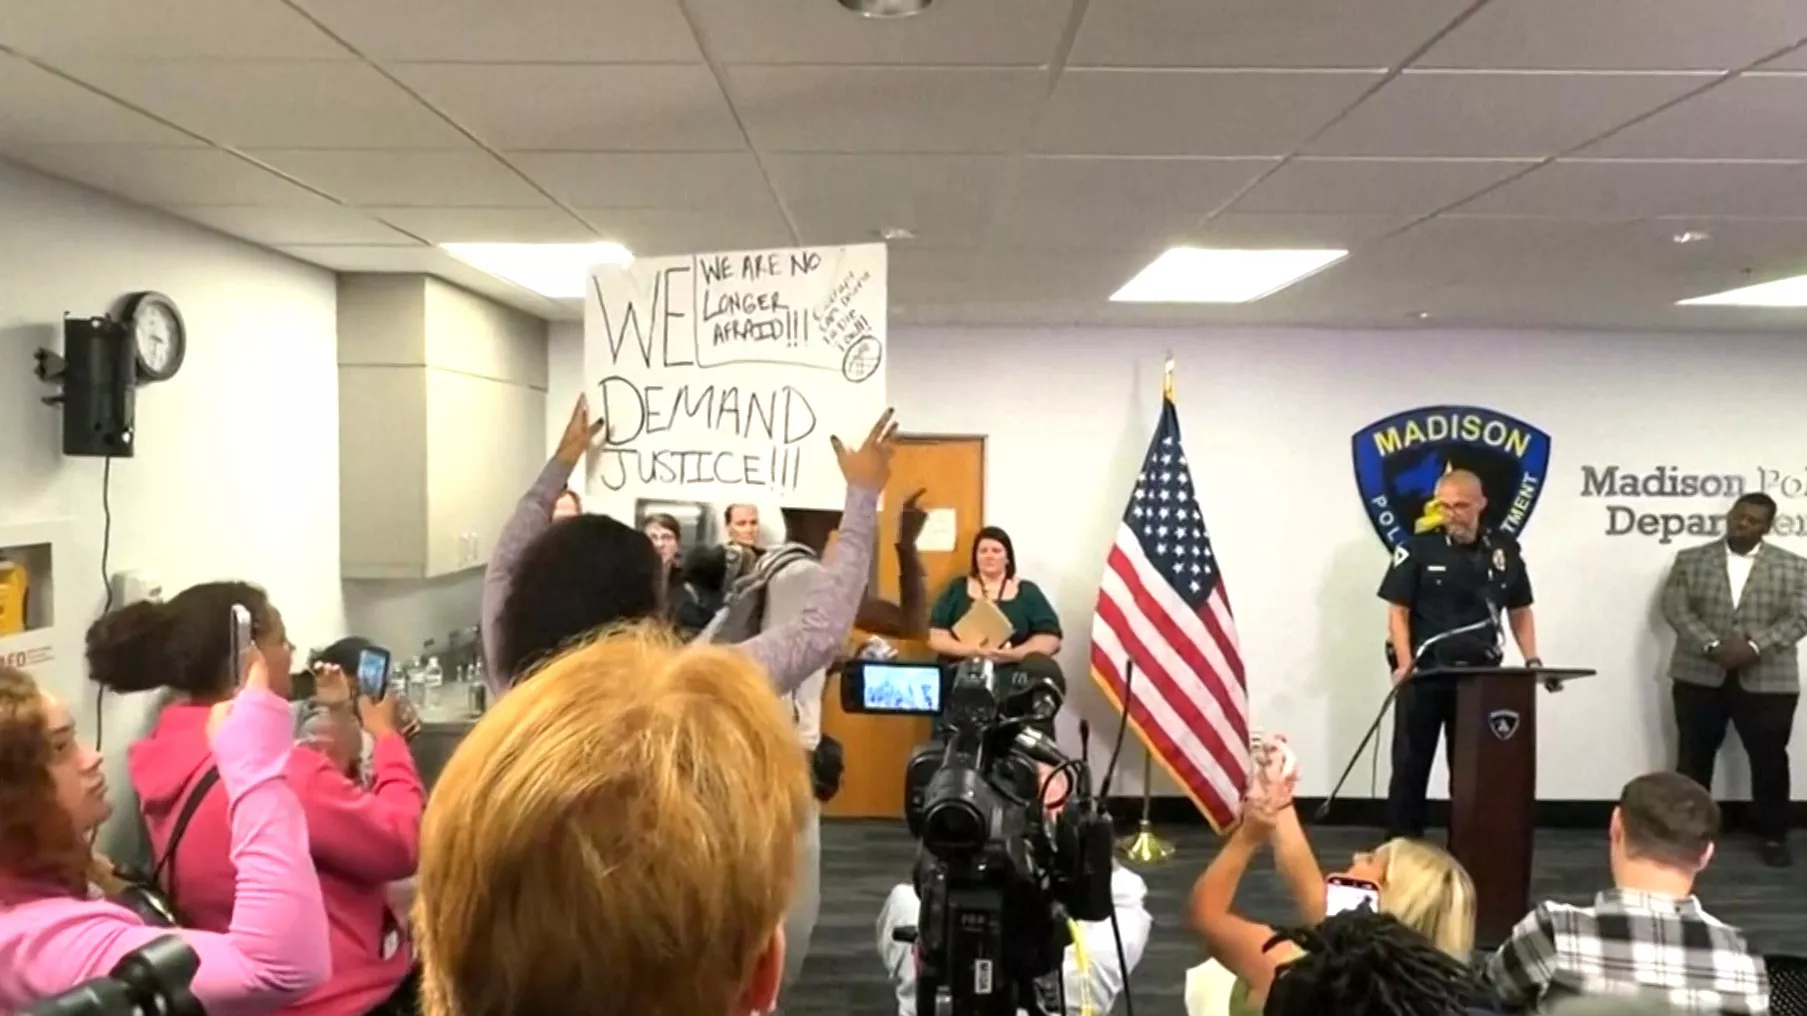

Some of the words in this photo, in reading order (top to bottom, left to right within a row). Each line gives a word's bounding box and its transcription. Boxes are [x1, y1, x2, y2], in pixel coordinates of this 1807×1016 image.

[701, 256, 733, 284] WE
[742, 254, 781, 280] ARE
[791, 252, 821, 277] NO
[593, 267, 694, 368] WE
[703, 290, 789, 321] LONGER
[713, 307, 808, 347] AFRAID!!!
[598, 375, 817, 445] DEMAND
[1374, 414, 1532, 458] MADISON
[600, 447, 801, 496] JUSTICE!!!
[1581, 465, 1746, 498] Madison
[1757, 465, 1807, 498] Po
[1500, 471, 1539, 533] TMENT
